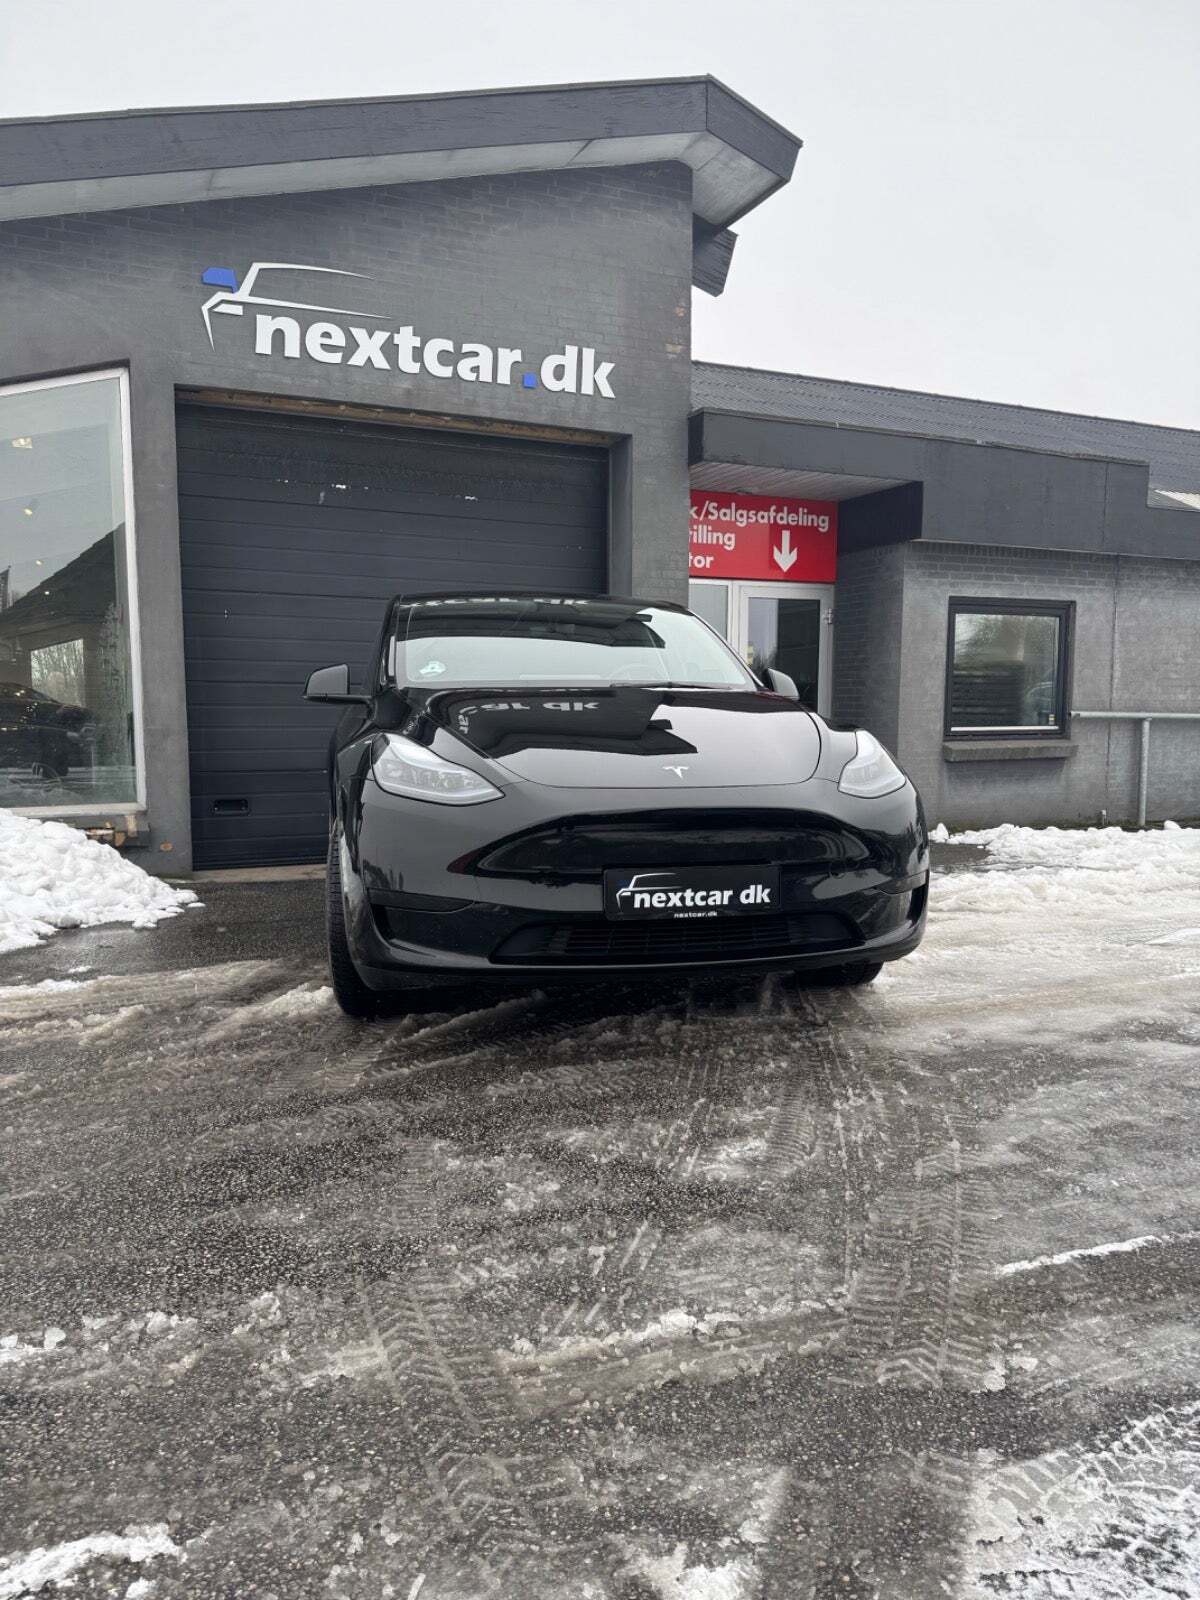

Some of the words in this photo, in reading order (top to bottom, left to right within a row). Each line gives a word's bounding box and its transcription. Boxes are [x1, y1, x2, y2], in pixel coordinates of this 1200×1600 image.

[255, 313, 616, 399] nextcar.dk
[633, 888, 734, 909] nextcar
[739, 884, 772, 904] dk
[673, 911, 718, 919] nextcar.dk
